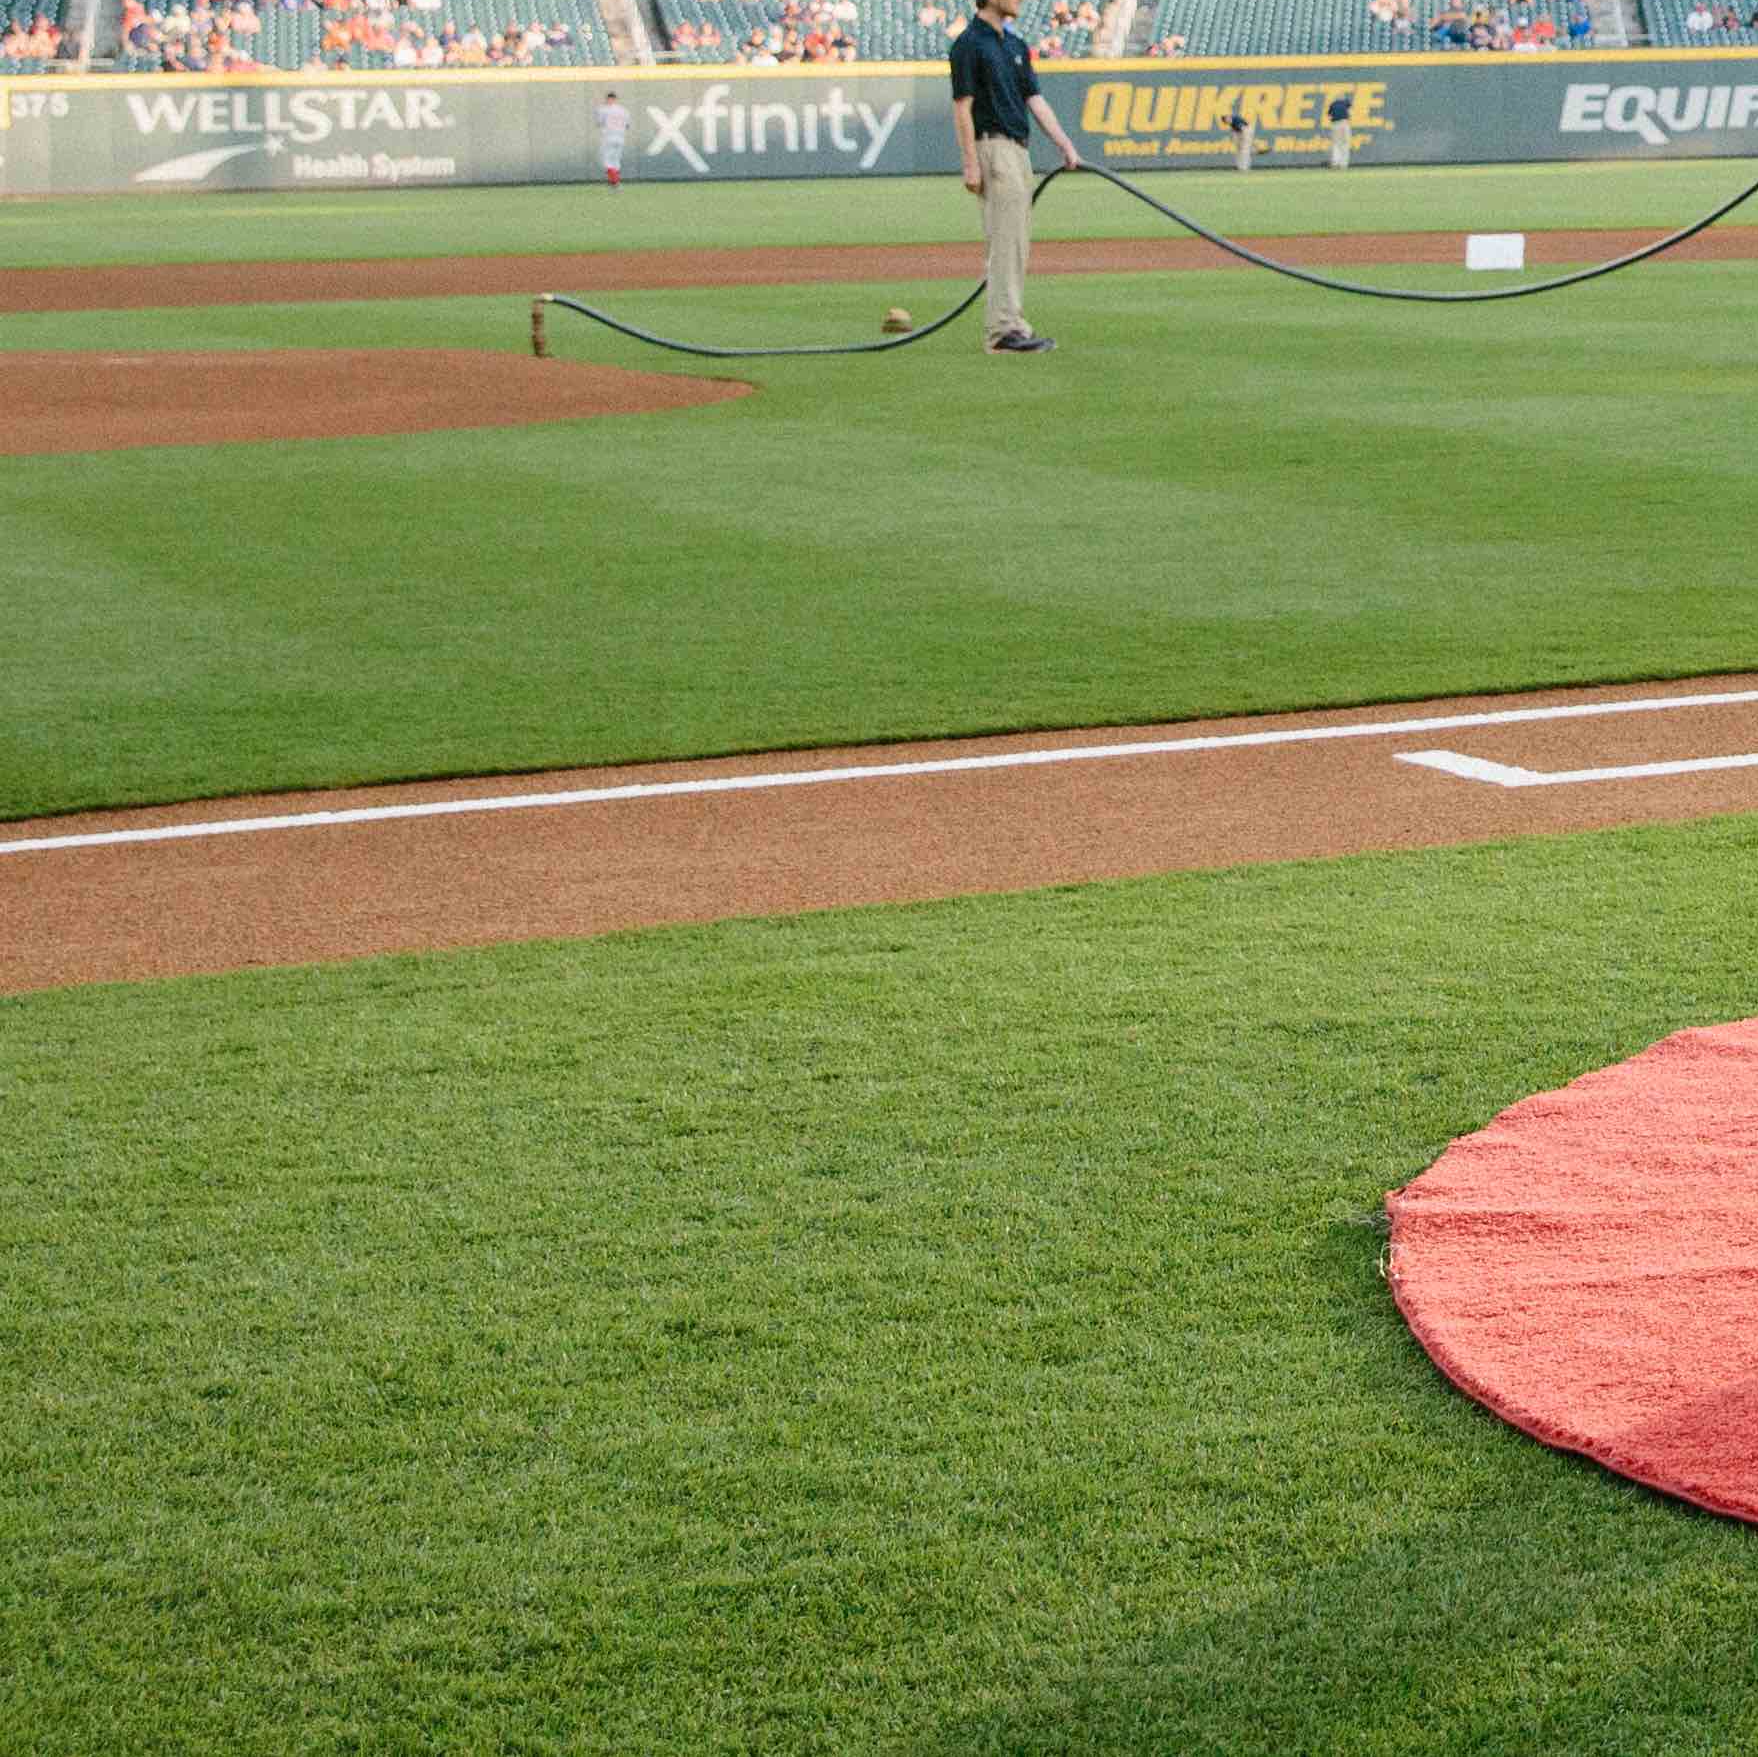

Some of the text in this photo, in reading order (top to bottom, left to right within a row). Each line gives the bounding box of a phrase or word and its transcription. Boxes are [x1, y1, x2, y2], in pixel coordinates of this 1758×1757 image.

[645, 83, 906, 173] xfinity
[293, 152, 457, 182] Health System
